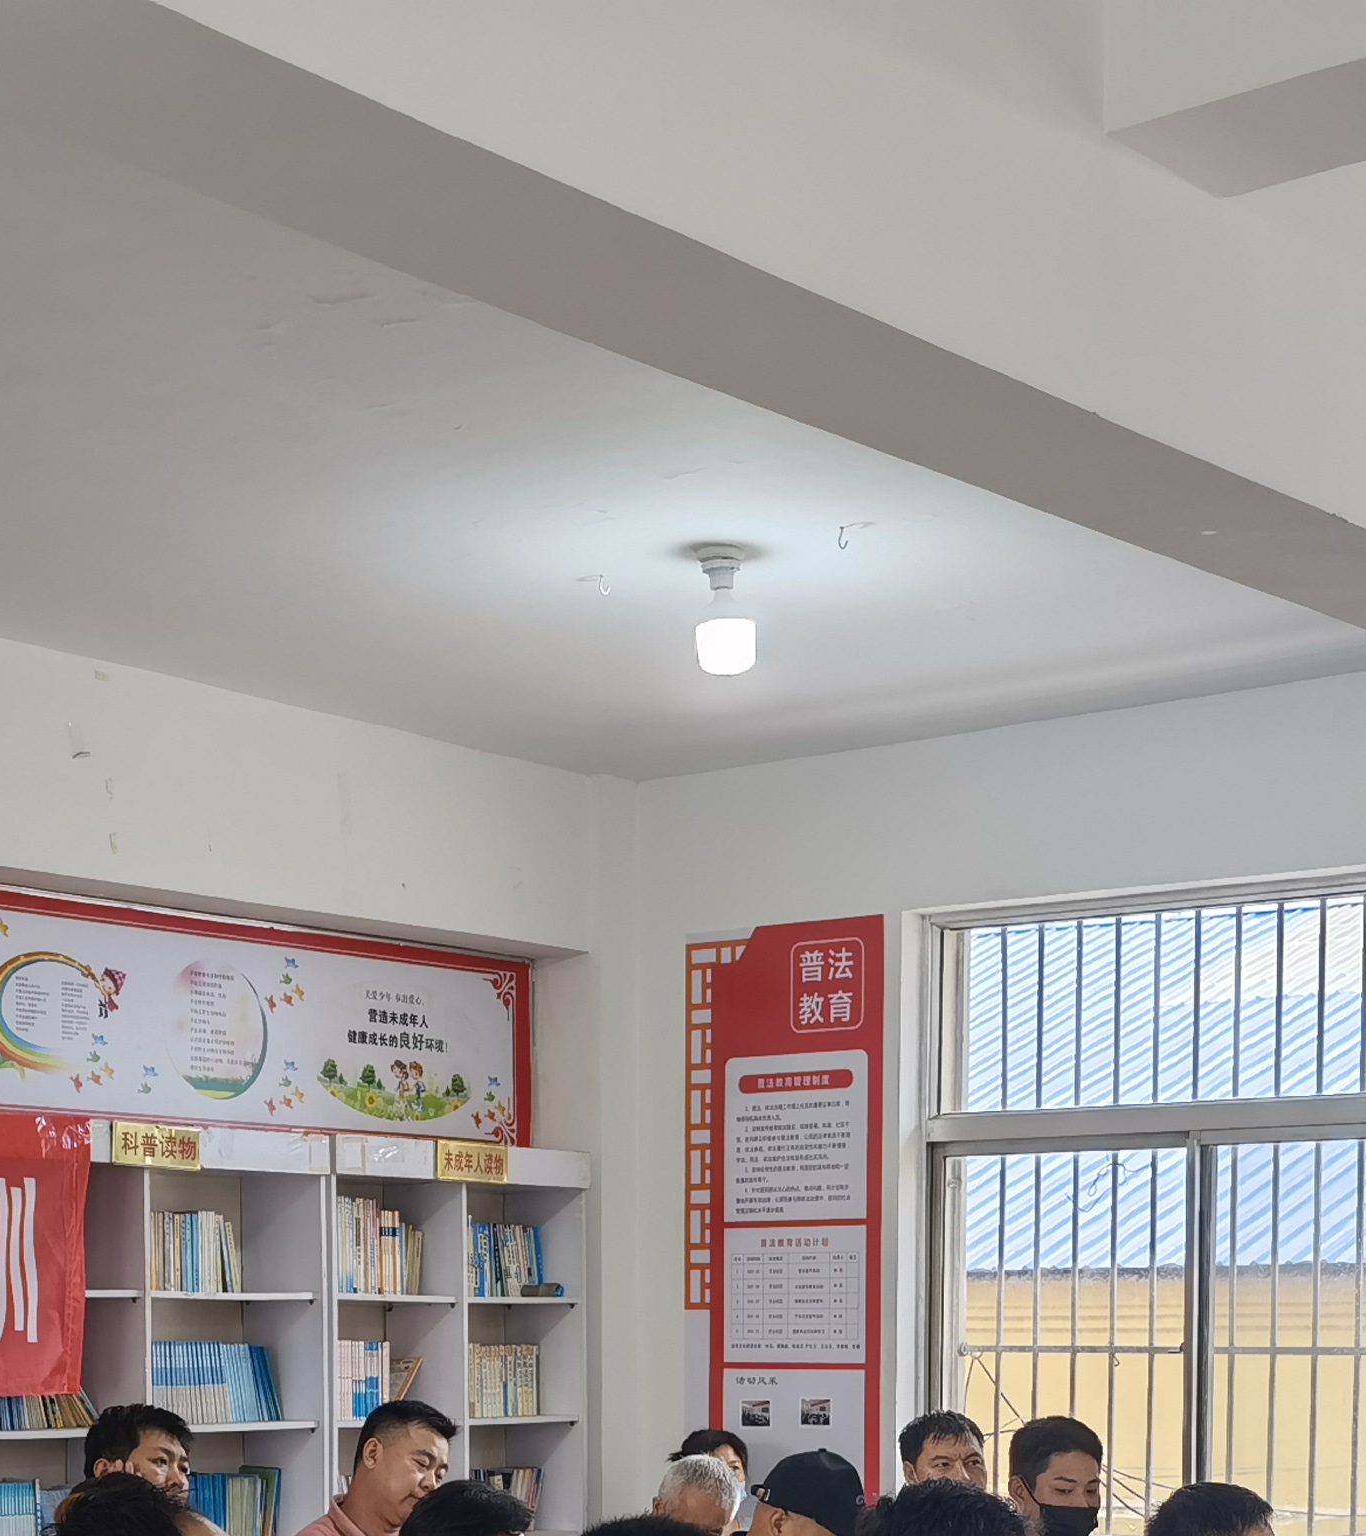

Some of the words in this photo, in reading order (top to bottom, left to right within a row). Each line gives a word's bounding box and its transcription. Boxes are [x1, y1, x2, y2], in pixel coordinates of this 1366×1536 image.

[799, 947, 853, 983] 普法
[367, 1008, 429, 1029] 营造未成年人
[798, 990, 853, 1025] 教育
[120, 1131, 198, 1160] 科普读物
[443, 1149, 504, 1176] 未成年人读物
